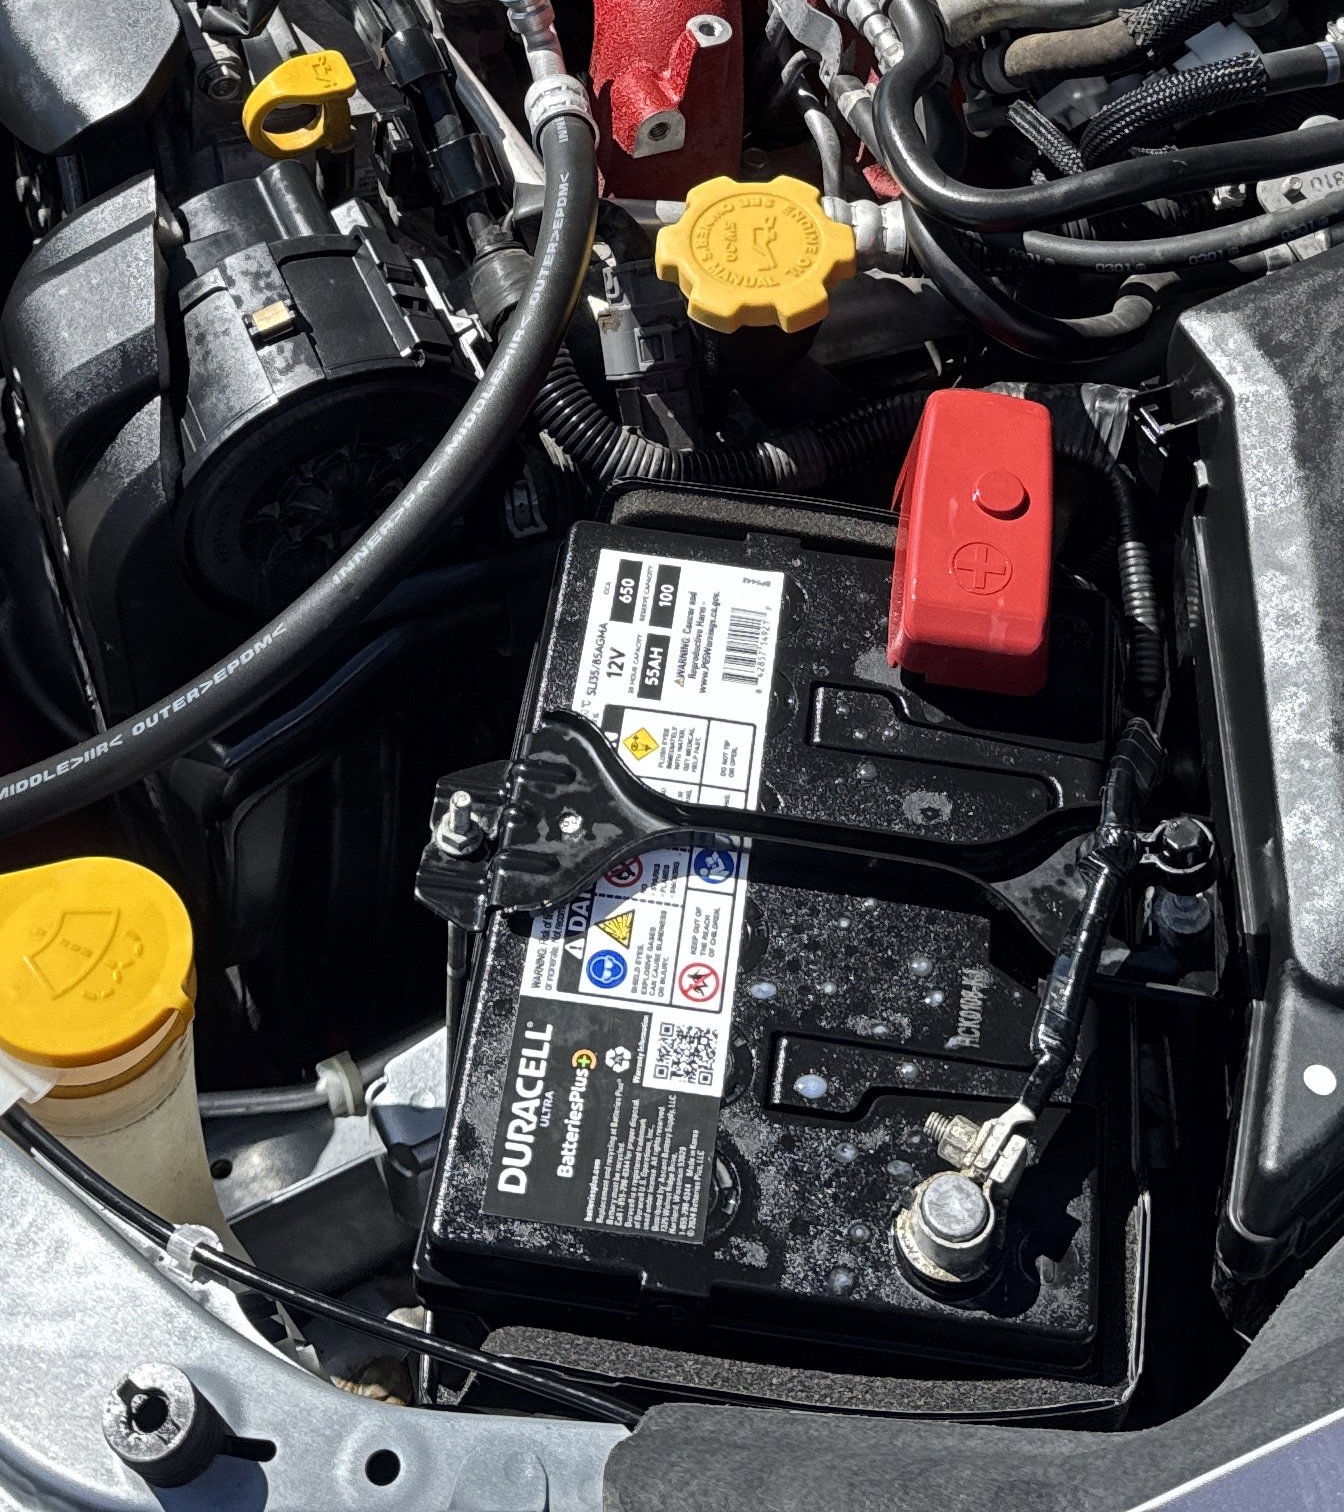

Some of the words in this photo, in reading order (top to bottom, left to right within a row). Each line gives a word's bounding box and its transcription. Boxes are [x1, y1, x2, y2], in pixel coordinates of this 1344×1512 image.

[701, 264, 780, 289] MANUAL
[602, 580, 611, 595] CCA
[618, 577, 635, 604] 650
[643, 564, 654, 595] CAPACITY
[657, 583, 675, 607] 100
[686, 590, 697, 605] and
[681, 606, 695, 634] Cancer
[604, 646, 626, 679] 12V
[632, 633, 643, 664] CAPACITY
[131, 621, 287, 737] OUTER>EPDM<
[643, 646, 664, 686] 55AH
[538, 1089, 554, 1128] ULTRA
